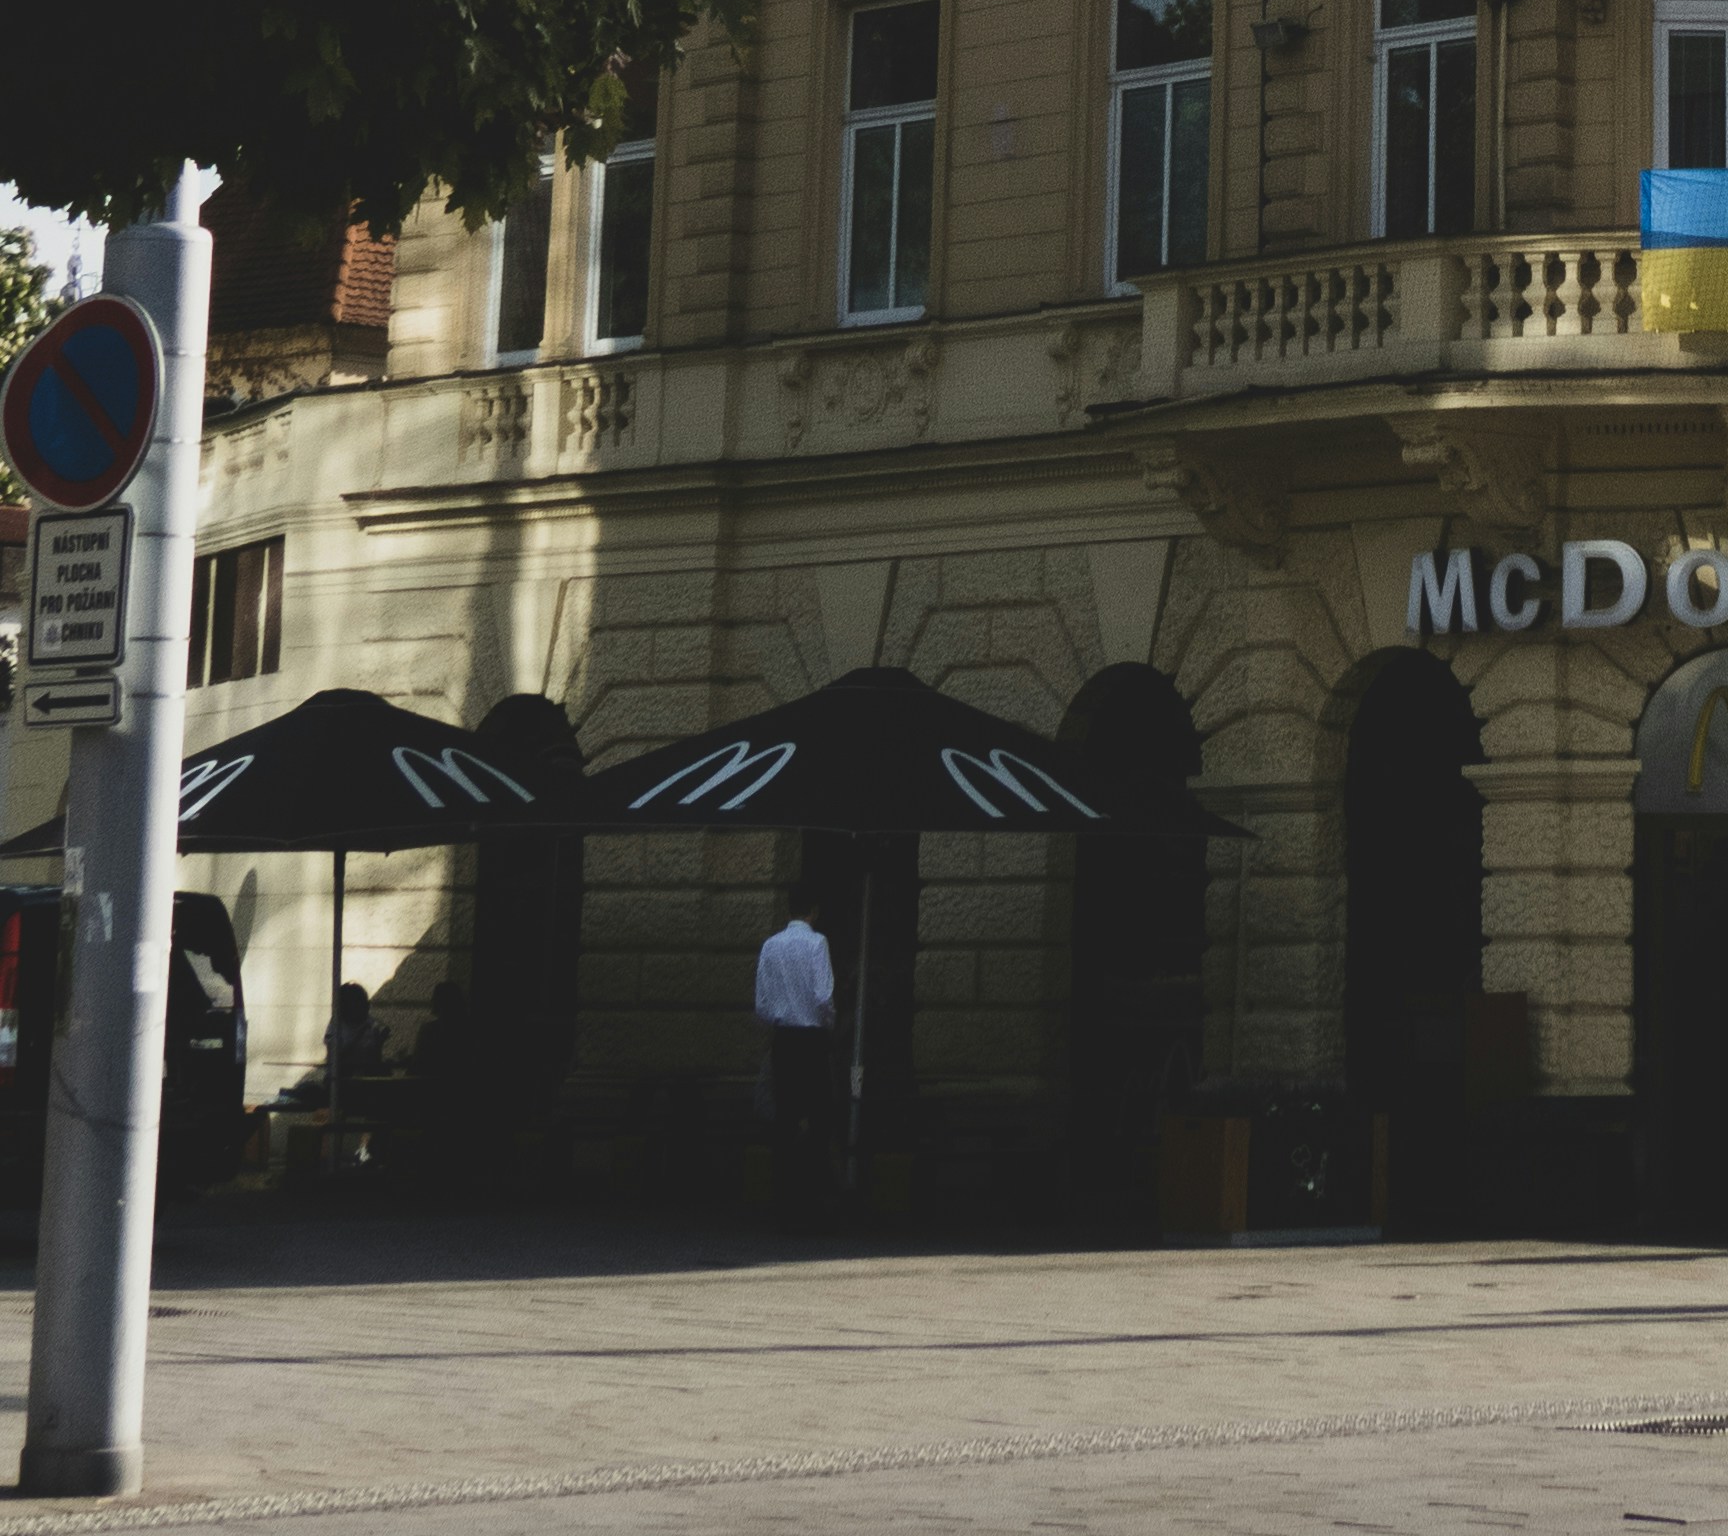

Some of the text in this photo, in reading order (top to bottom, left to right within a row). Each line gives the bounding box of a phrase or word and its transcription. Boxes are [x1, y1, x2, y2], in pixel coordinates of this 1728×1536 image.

[52, 526, 112, 554] NÁSTUPNÍ
[56, 562, 101, 583] PLOCHA
[39, 585, 117, 614] PRO POŽÁRNÍ
[44, 621, 104, 643] CHNIKU
